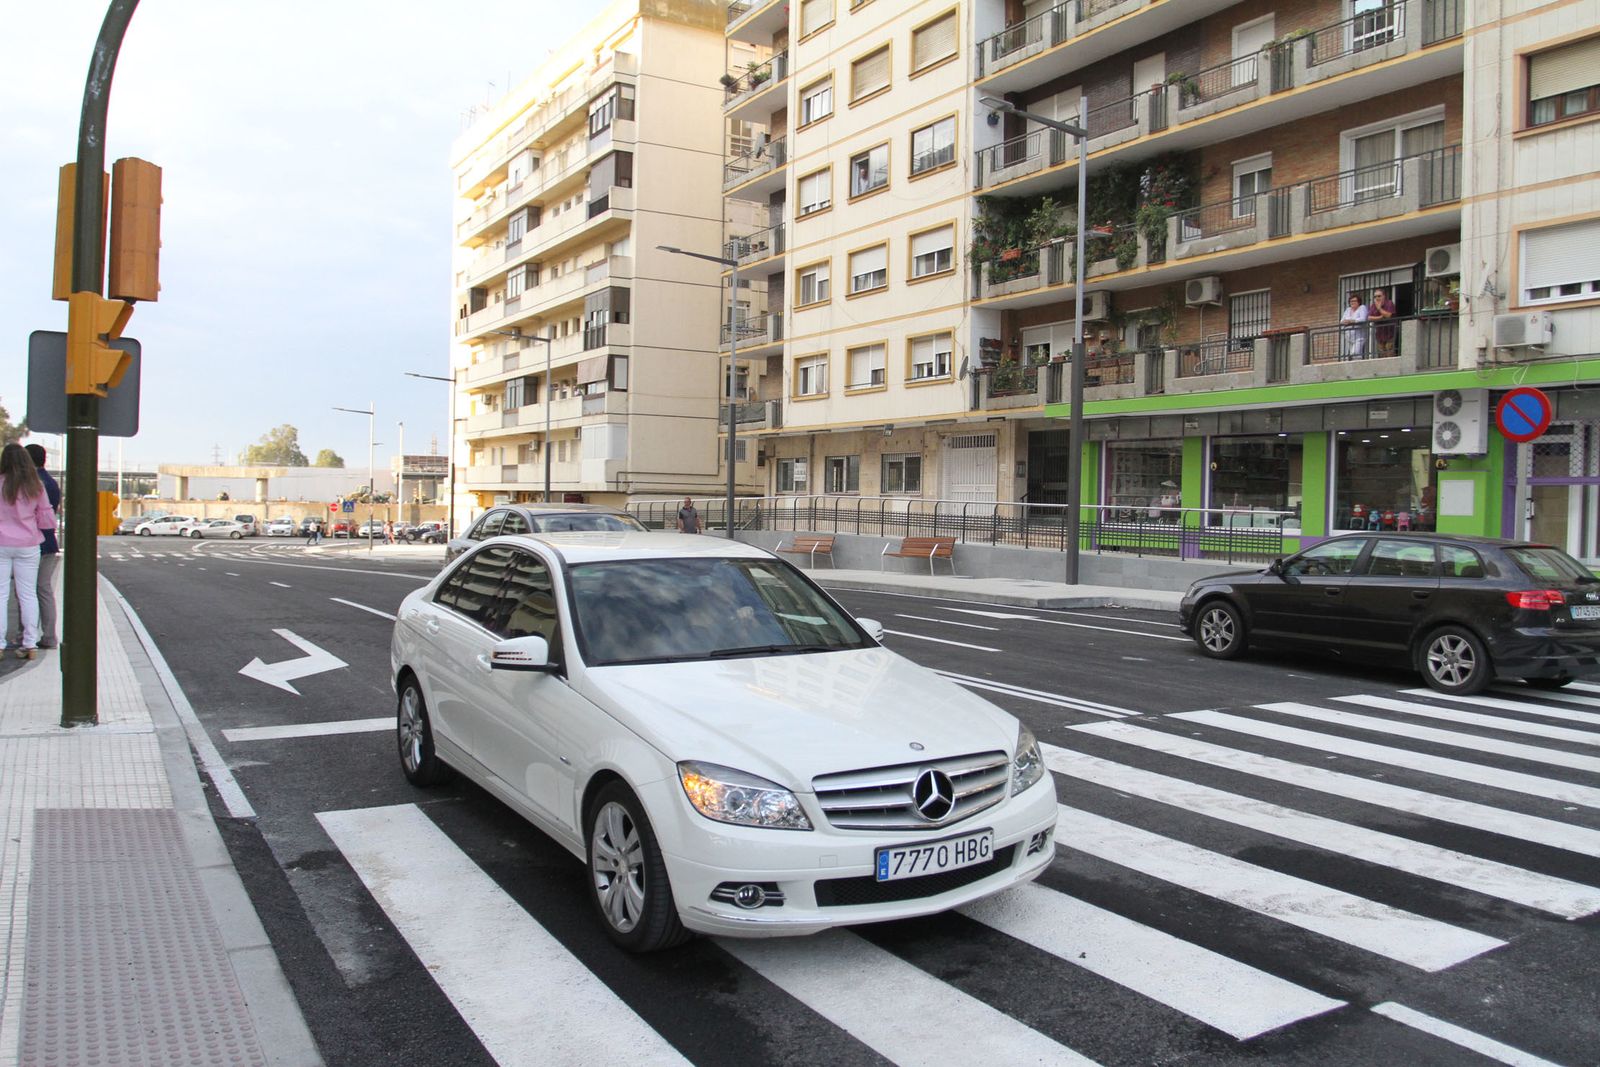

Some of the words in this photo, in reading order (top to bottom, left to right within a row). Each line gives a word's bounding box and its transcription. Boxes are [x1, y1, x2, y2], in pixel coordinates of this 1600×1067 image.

[893, 845, 949, 875] 7770
[955, 836, 989, 865] HBG
[880, 868, 887, 876] E
